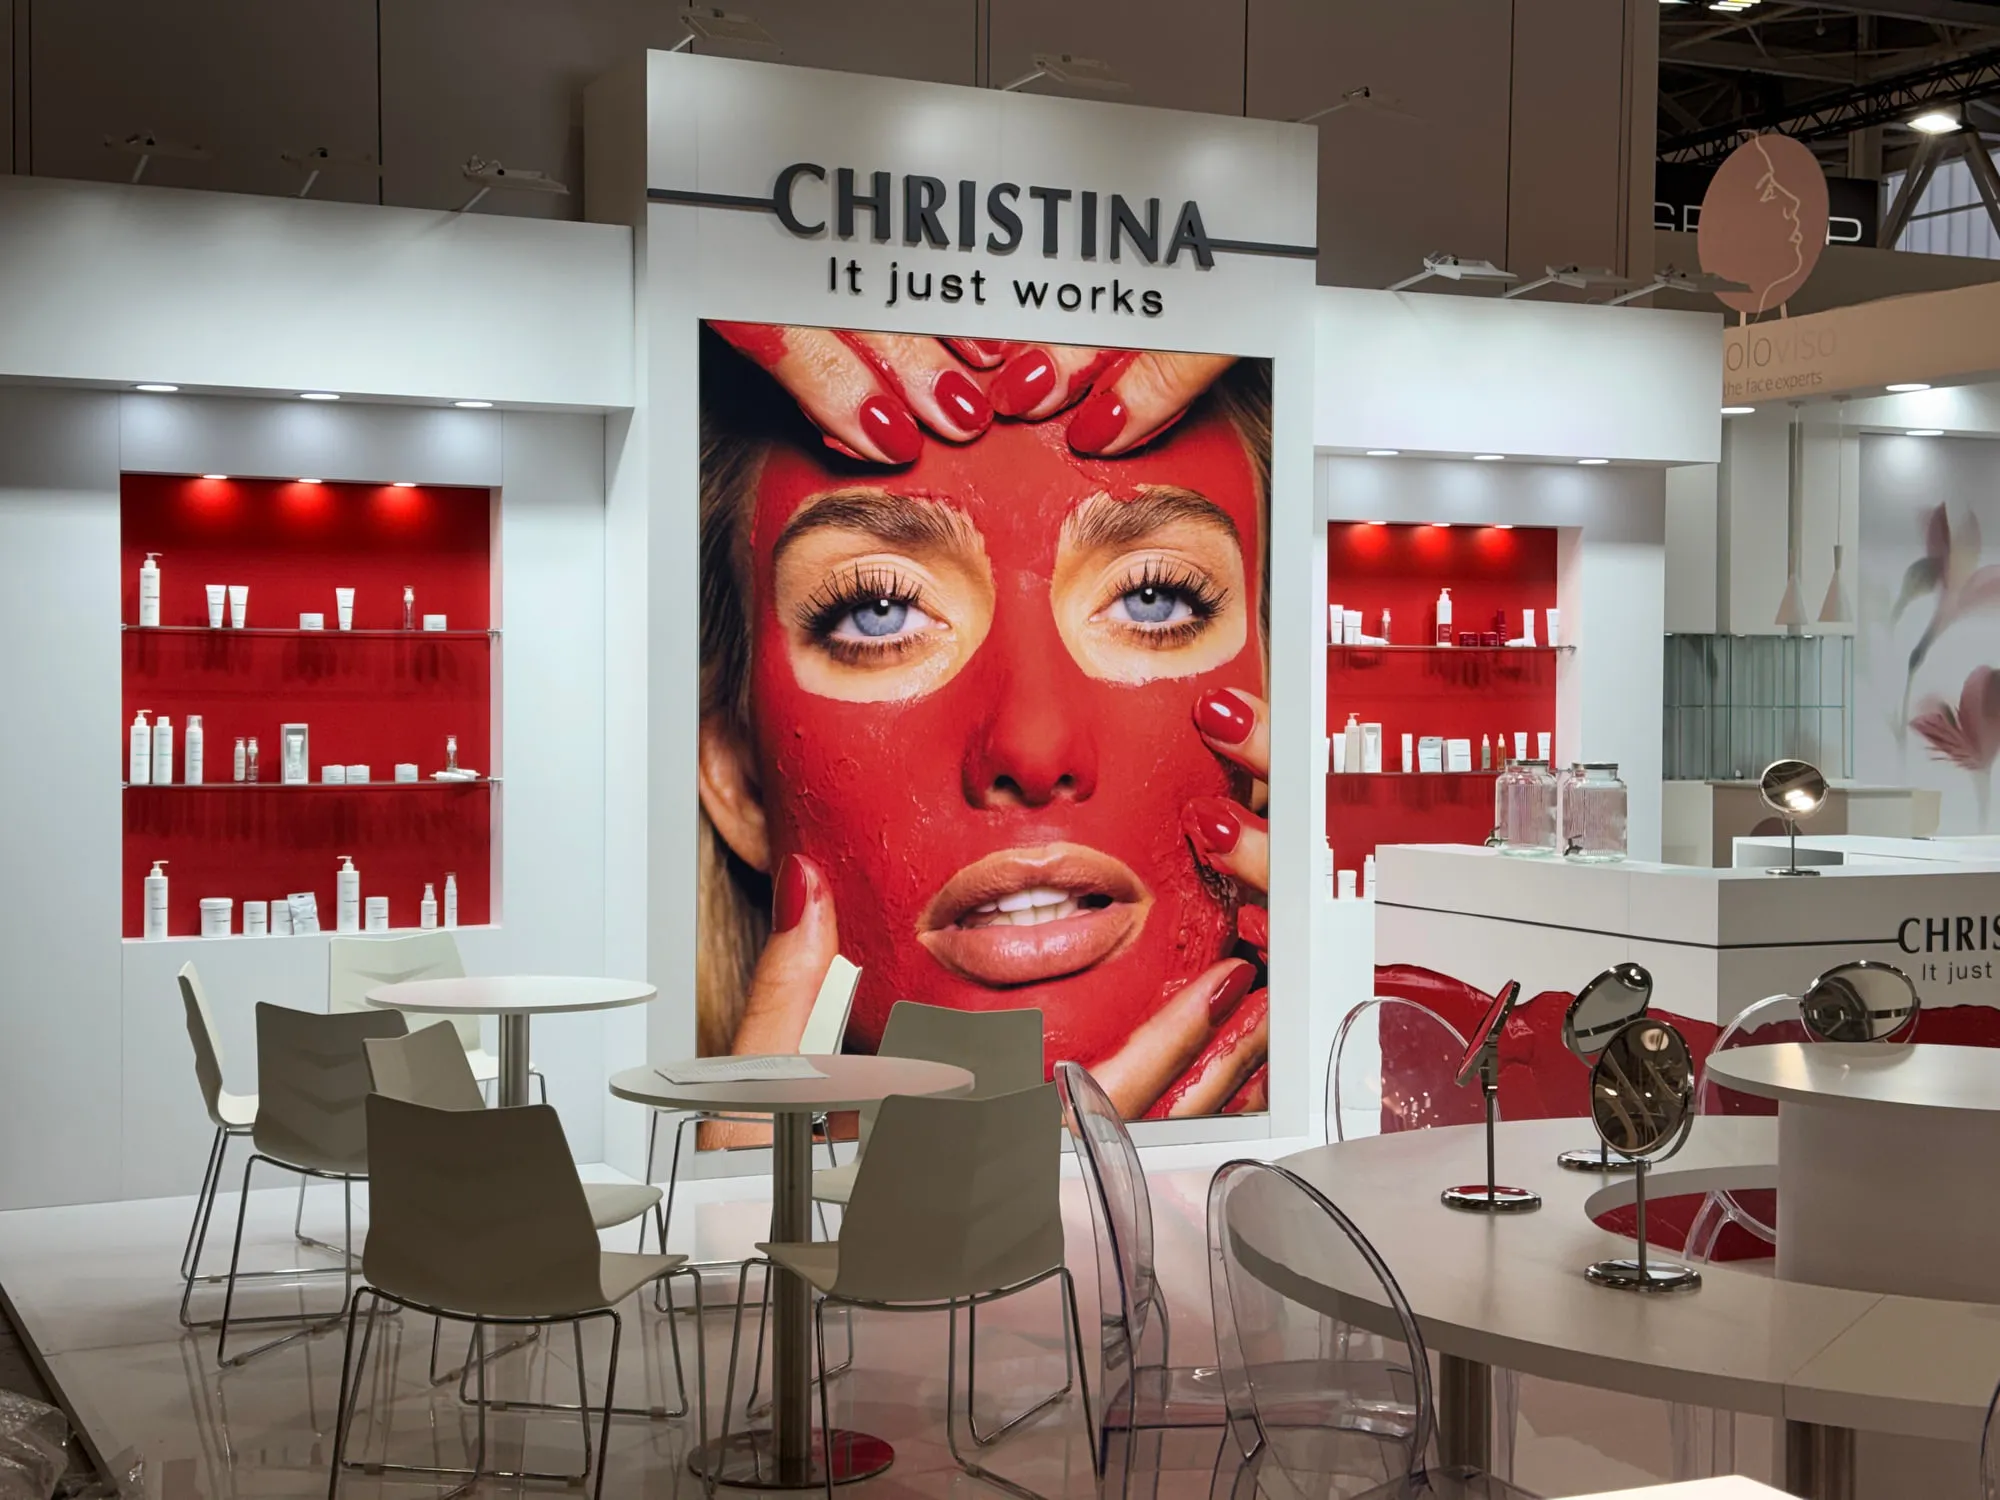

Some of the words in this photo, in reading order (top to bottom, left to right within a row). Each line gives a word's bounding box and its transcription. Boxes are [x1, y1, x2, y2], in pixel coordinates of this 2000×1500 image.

[773, 162, 1215, 270] CHRISTINA
[829, 256, 863, 294] It
[884, 260, 987, 307] just
[1012, 277, 1165, 316] works
[1745, 376, 1774, 394] face
[1775, 371, 1823, 391] experts
[1922, 962, 1937, 981] It
[1947, 961, 1992, 985] just
